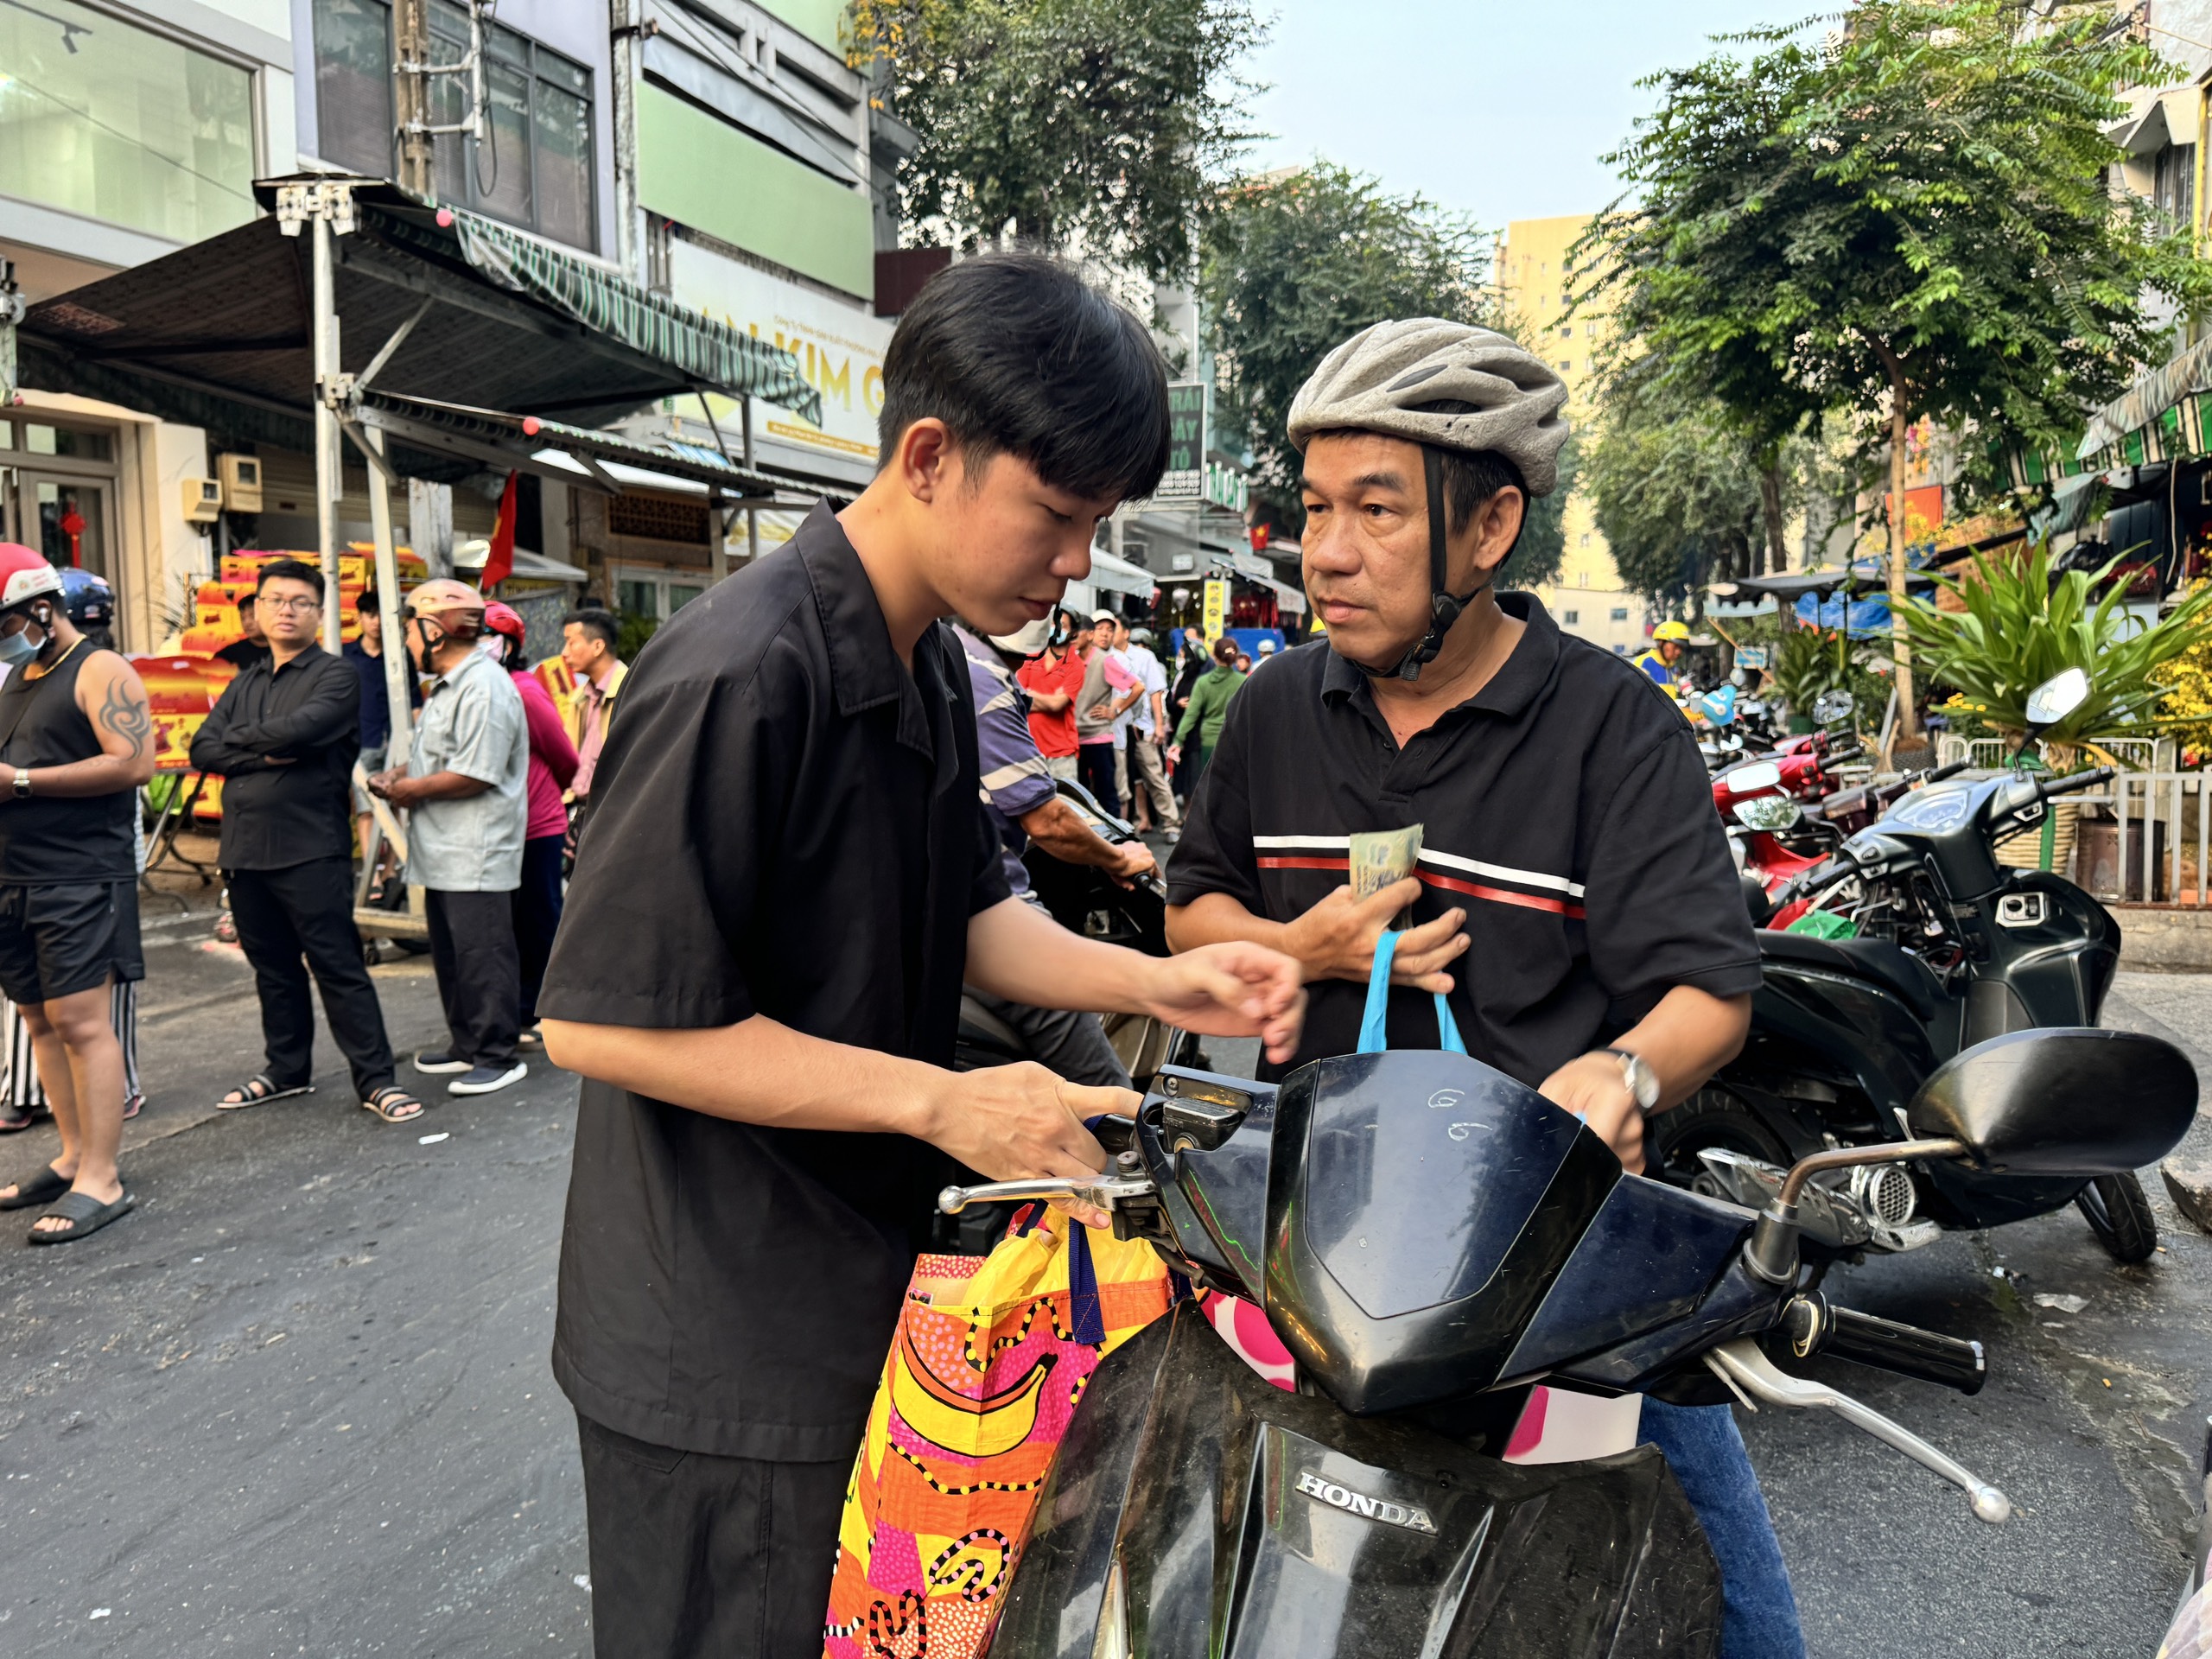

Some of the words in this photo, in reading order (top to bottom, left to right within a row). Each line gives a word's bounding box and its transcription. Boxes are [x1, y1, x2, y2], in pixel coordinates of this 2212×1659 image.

[1170, 386, 1201, 412] RÁI
[1171, 416, 1198, 441] ÂY
[1295, 1471, 1438, 1535] HONDA
